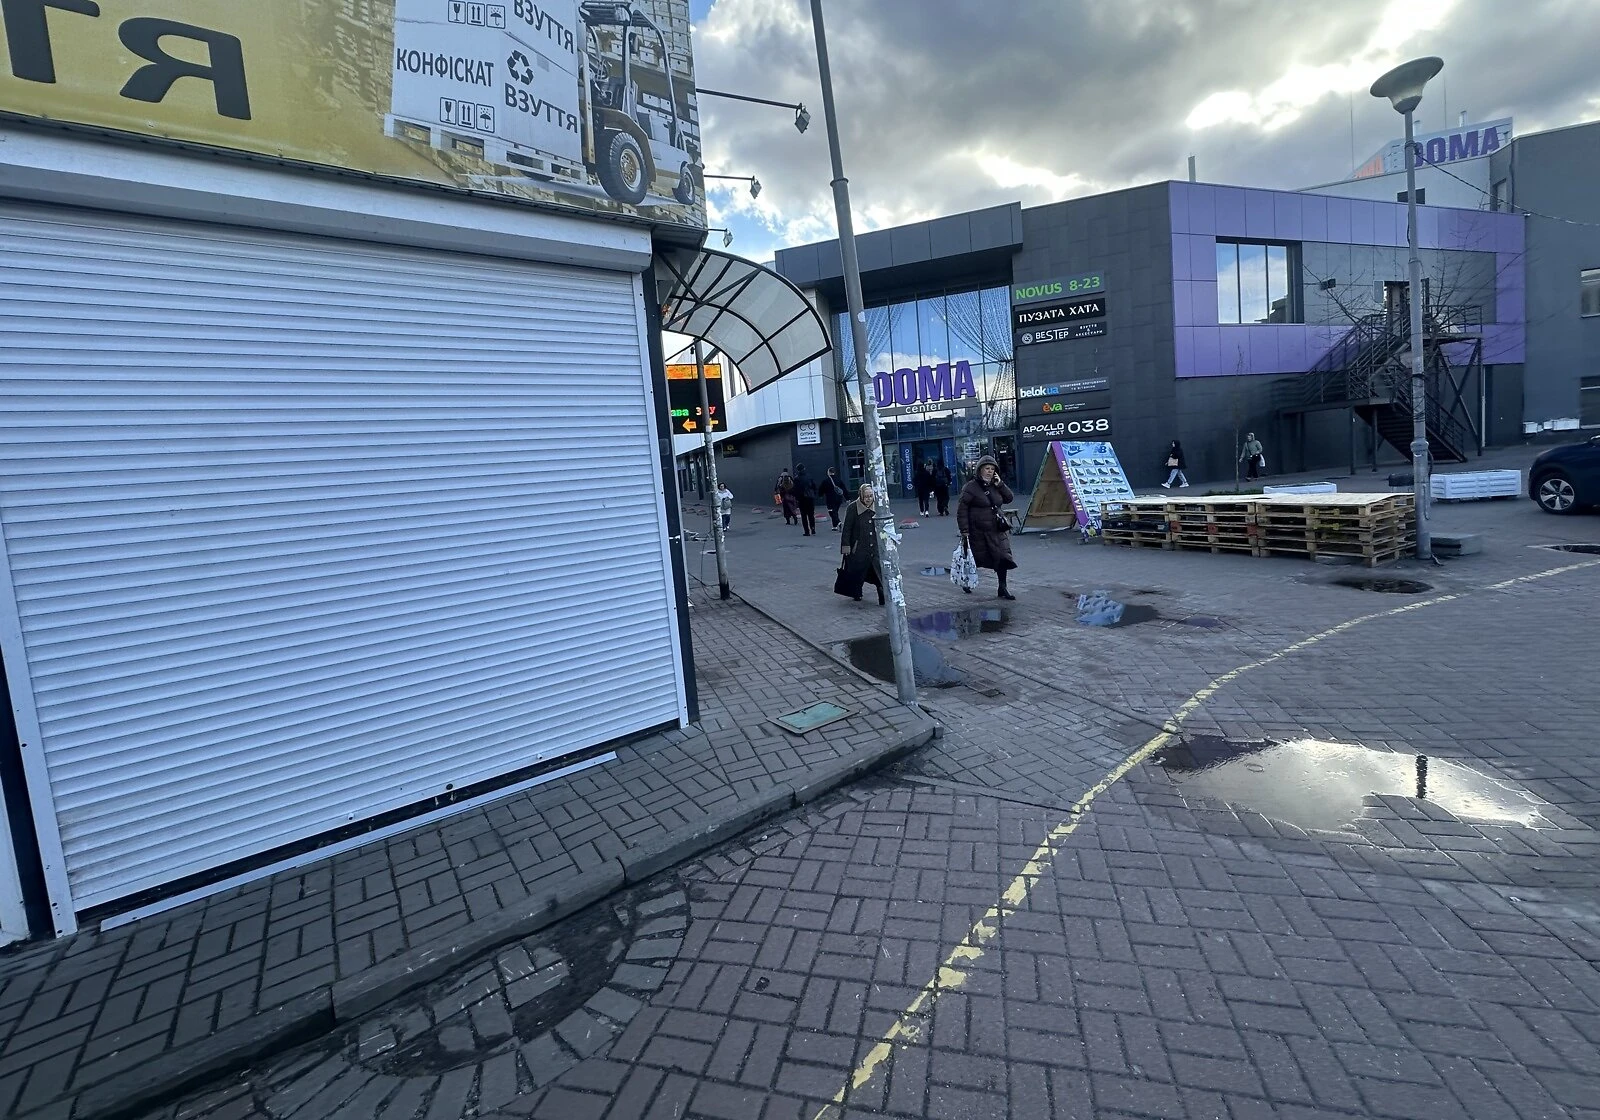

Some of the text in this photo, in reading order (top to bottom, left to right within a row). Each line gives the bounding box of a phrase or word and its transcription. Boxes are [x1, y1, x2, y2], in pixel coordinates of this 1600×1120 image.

[513, 0, 574, 54] ВЗУТТЯ
[396, 48, 495, 87] КОНФІСКАТ
[504, 82, 578, 133] ВЗУТТЯ
[1015, 276, 1100, 300] NOVUS 8-23
[1018, 303, 1100, 323] ПУЗАТА ХАТА
[872, 359, 977, 409] DOMA
[905, 402, 943, 414] center
[1022, 418, 1109, 434] APOLLO 038
